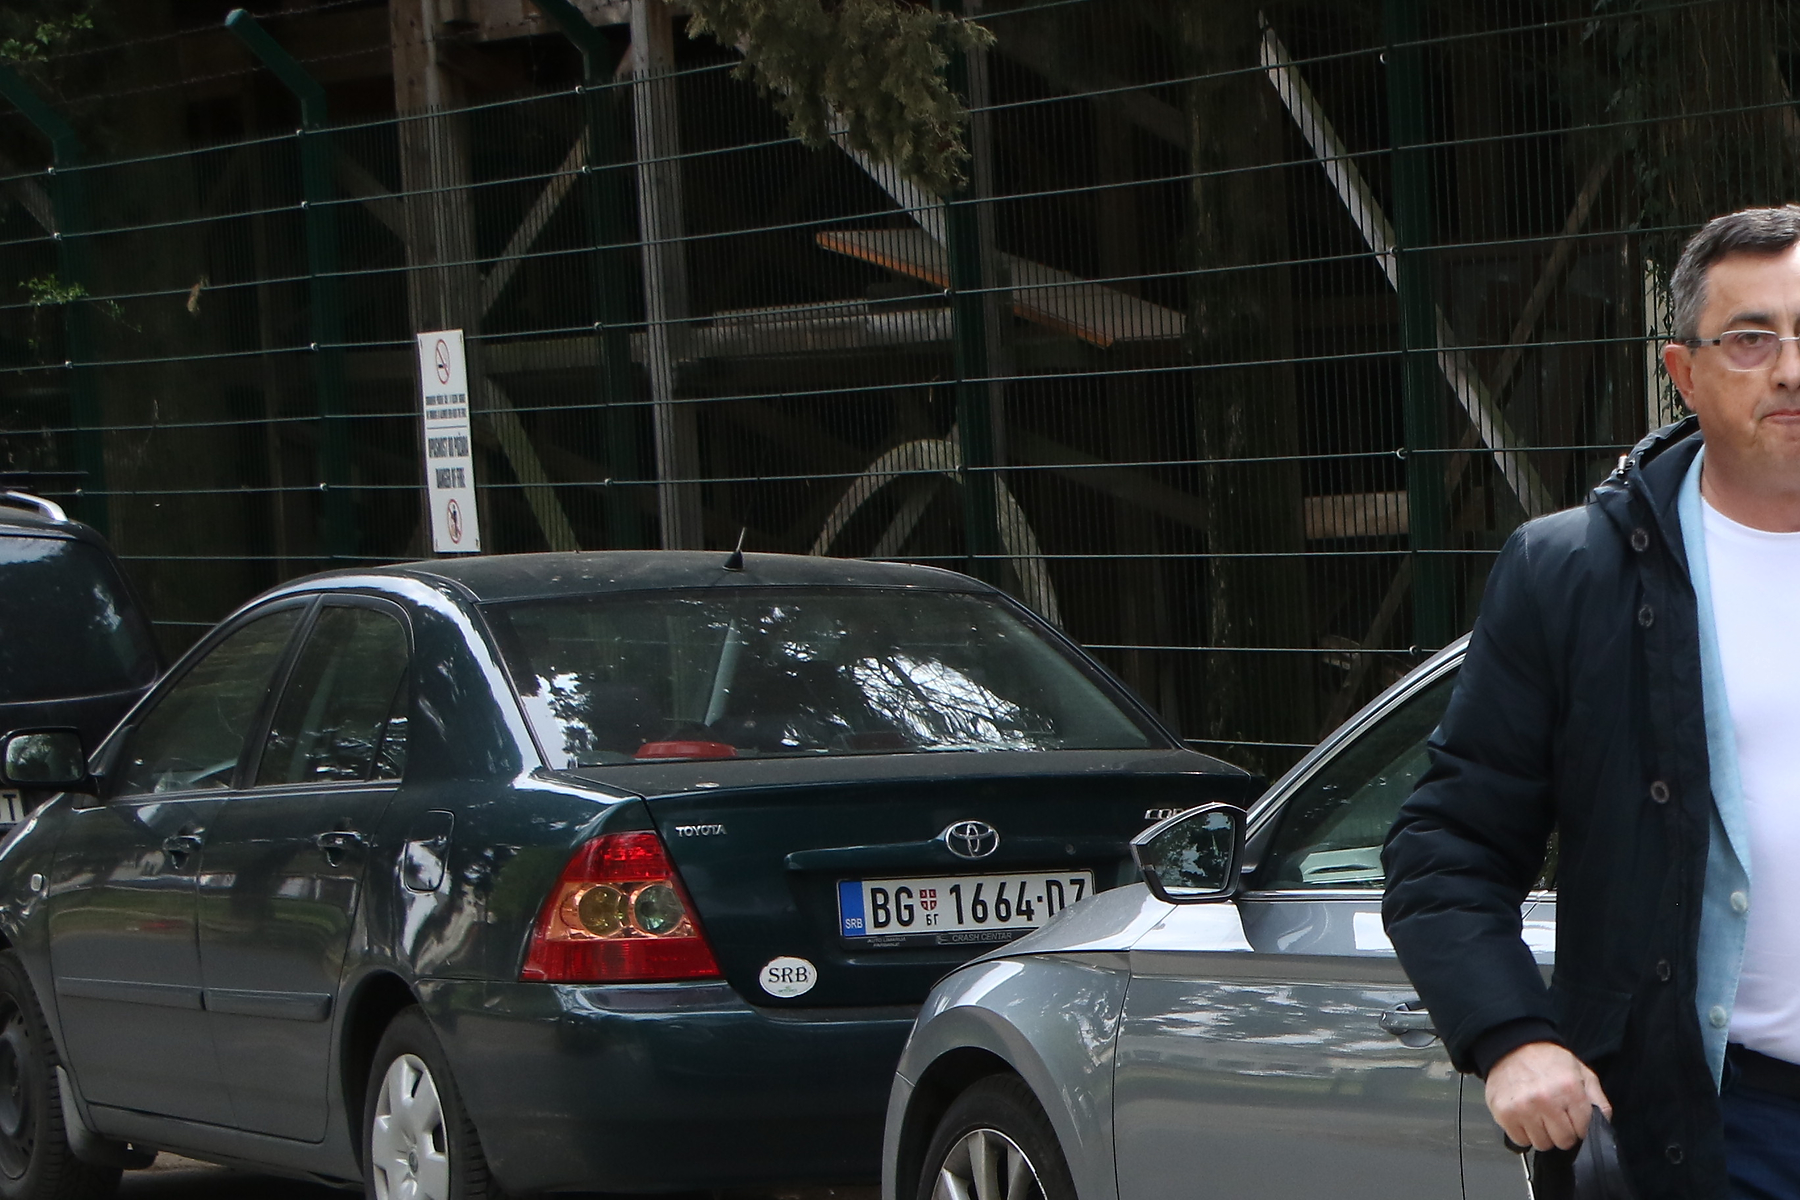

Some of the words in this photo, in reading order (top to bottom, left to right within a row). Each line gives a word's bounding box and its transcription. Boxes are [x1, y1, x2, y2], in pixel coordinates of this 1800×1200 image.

[675, 824, 727, 838] TOYOTA
[870, 886, 915, 929] BG
[845, 917, 863, 930] SRB
[952, 933, 979, 942] CRASH
[981, 932, 1012, 941] CENTAR
[768, 966, 808, 983] SRB
